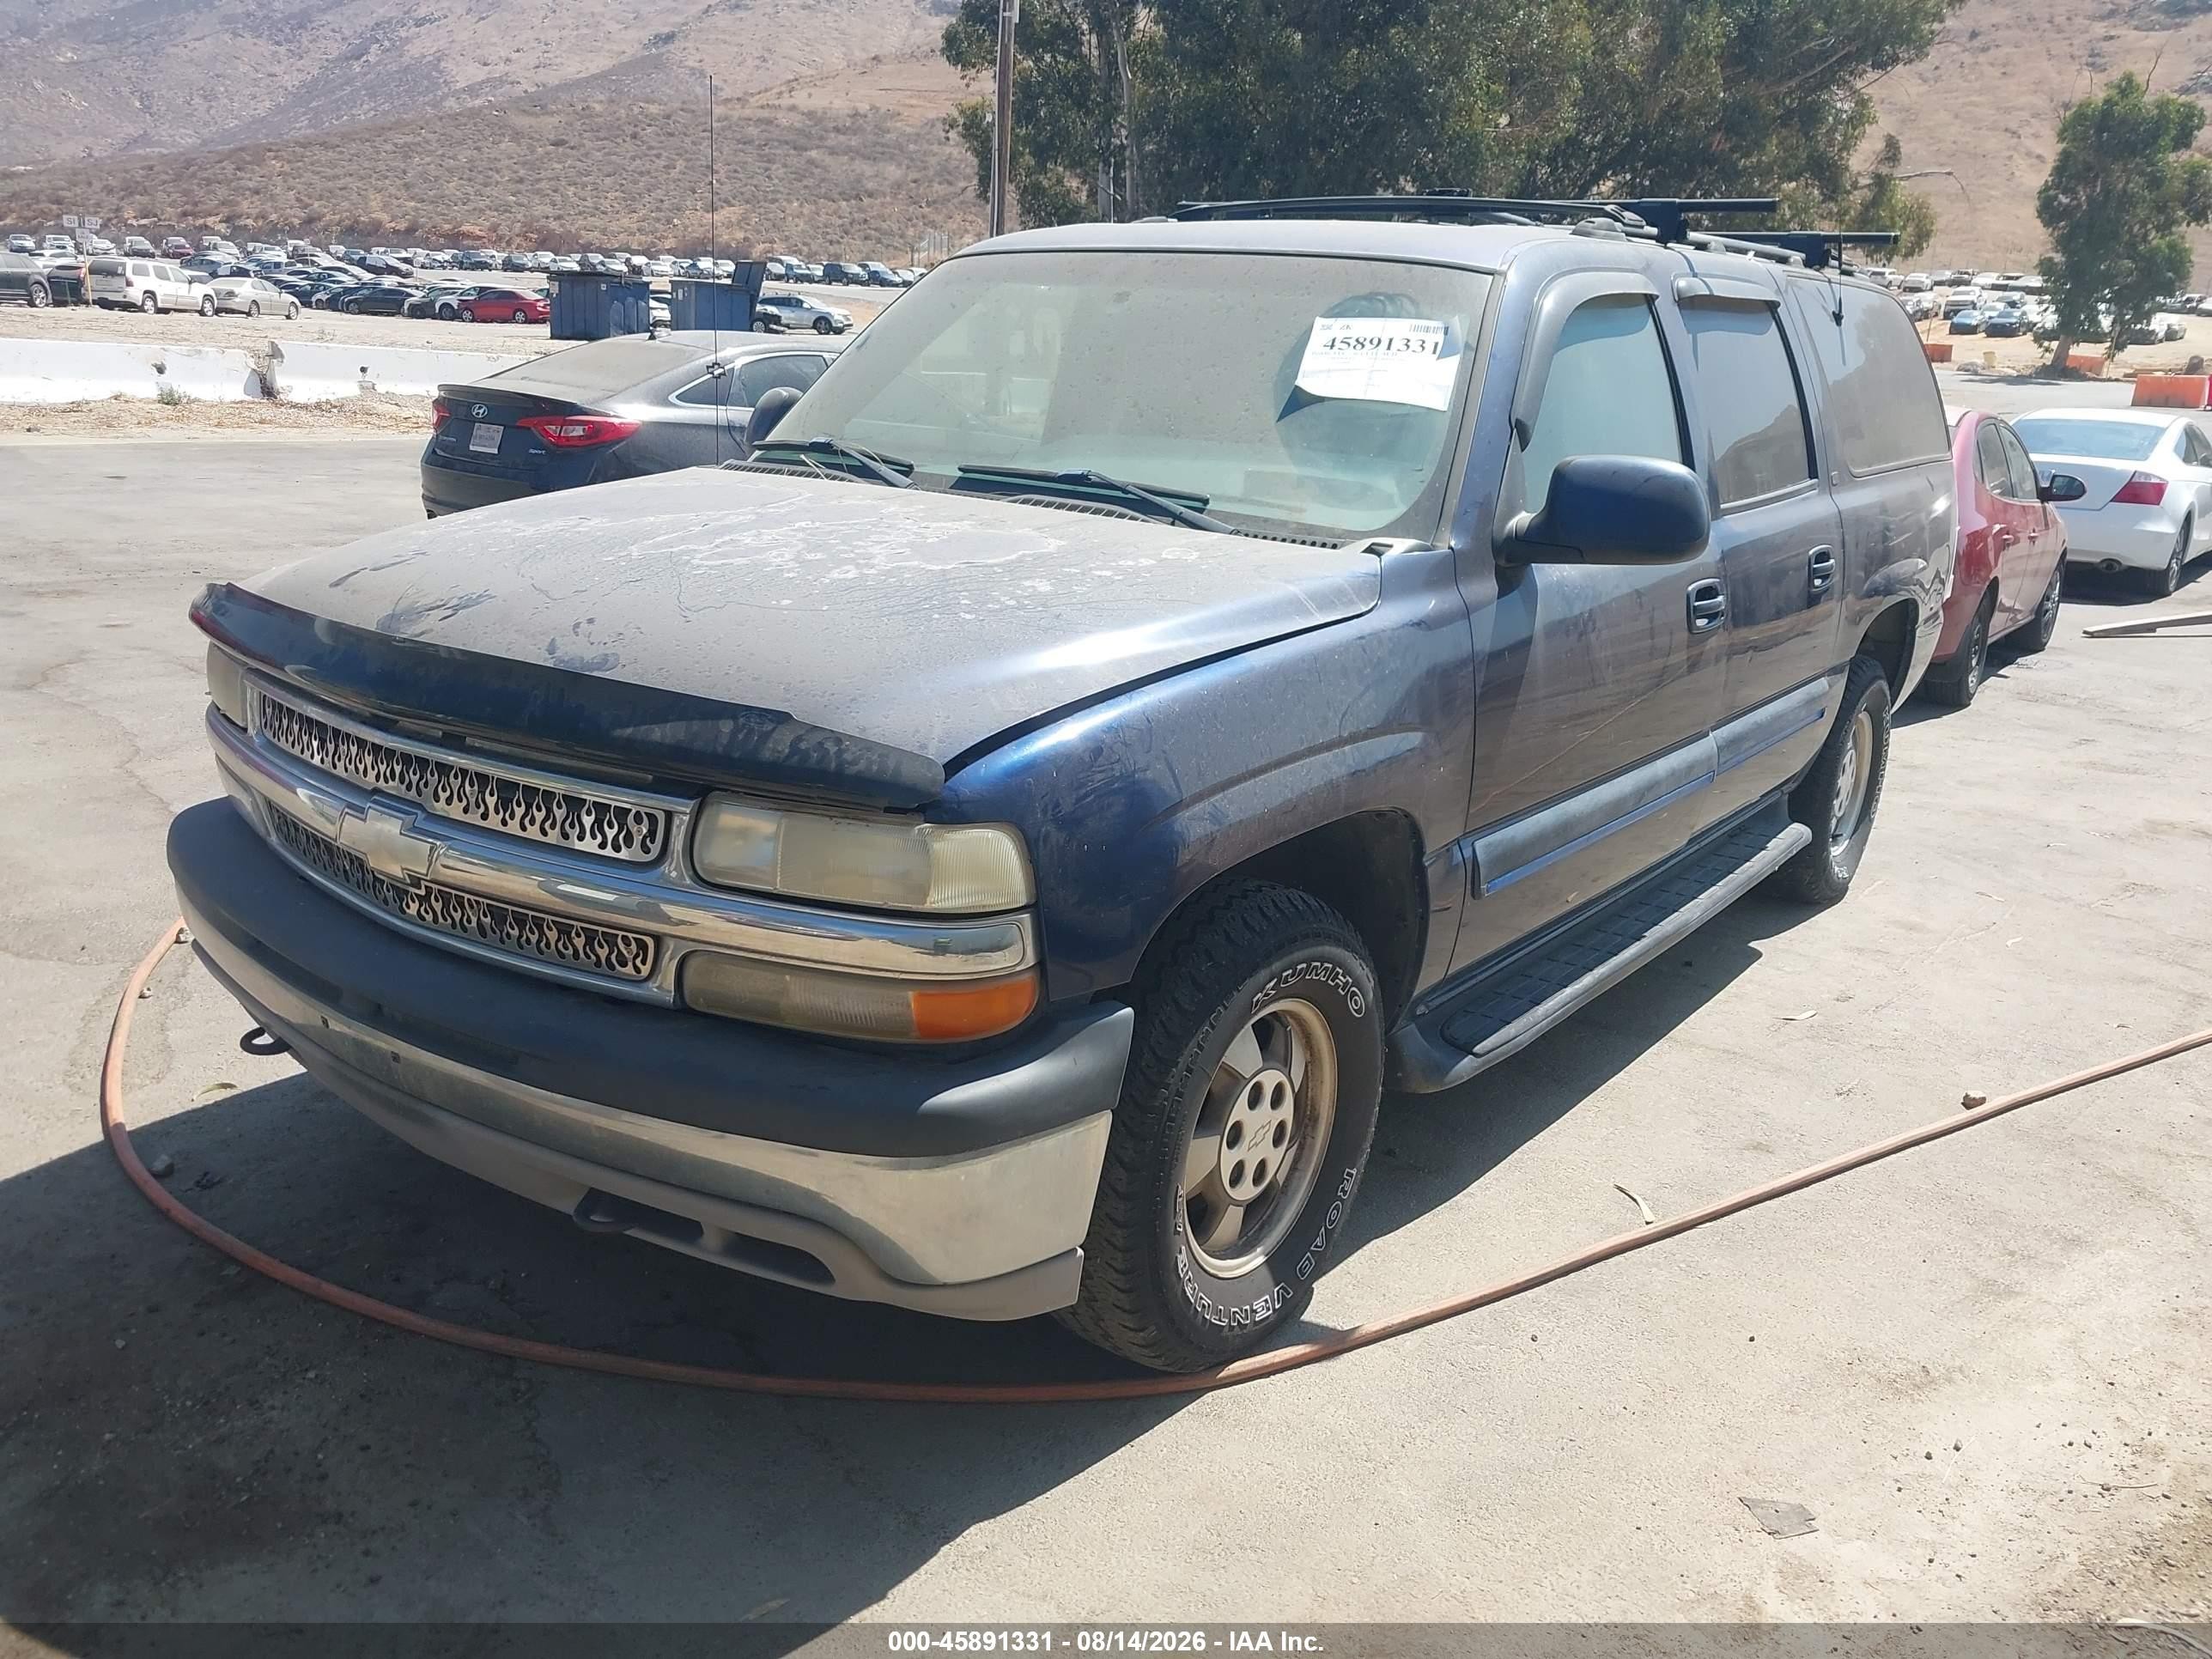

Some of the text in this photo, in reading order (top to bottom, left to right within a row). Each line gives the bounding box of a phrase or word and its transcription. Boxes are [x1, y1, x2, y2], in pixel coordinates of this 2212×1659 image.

[1322, 336, 1439, 356] 45891331
[1250, 961, 1365, 1018] KUMHO
[1296, 1168, 1357, 1280] ROAD
[1177, 1246, 1293, 1326] VENTURE
